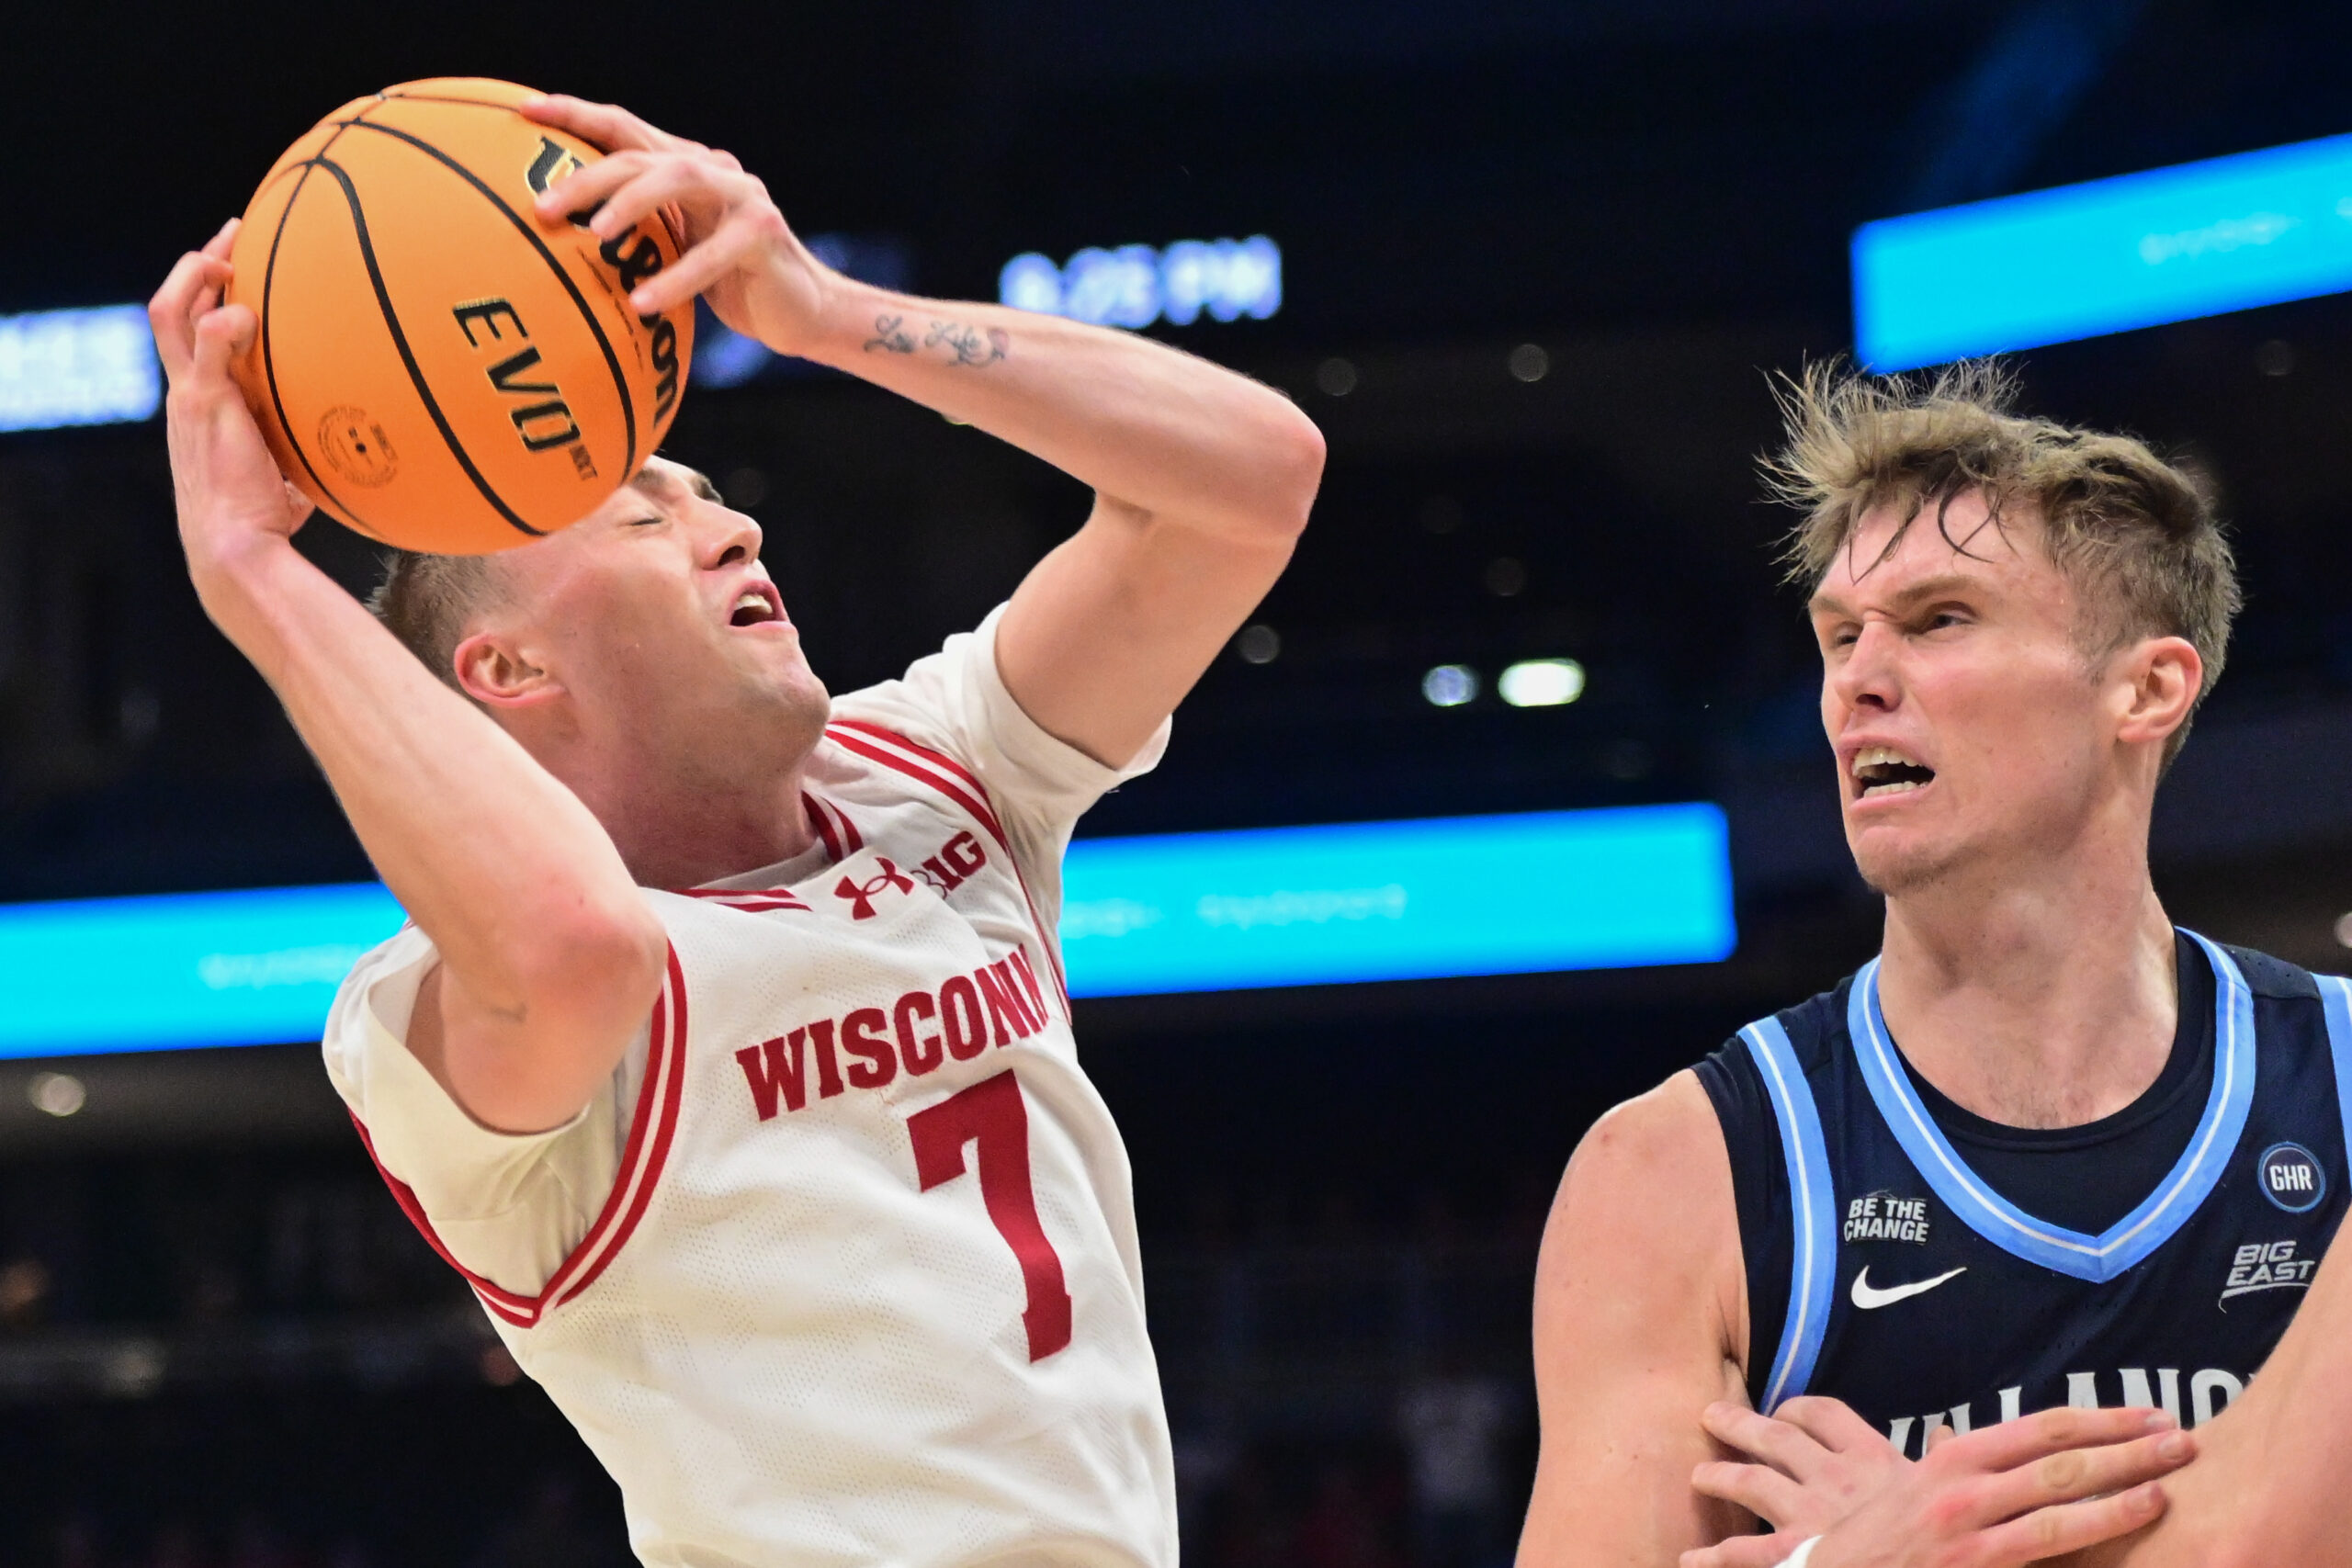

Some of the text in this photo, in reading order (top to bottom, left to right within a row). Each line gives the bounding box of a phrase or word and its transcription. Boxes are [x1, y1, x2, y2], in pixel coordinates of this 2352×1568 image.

[453, 295, 581, 454] EVO
[735, 943, 1049, 1122] WISCONIN
[2269, 1165, 2312, 1190] GHR
[907, 1068, 1072, 1363] 7
[1849, 1198, 1927, 1221] BE THE
[1844, 1218, 1929, 1242] CHANGE
[2233, 1241, 2297, 1266] BIG
[2226, 1260, 2315, 1286] EAST
